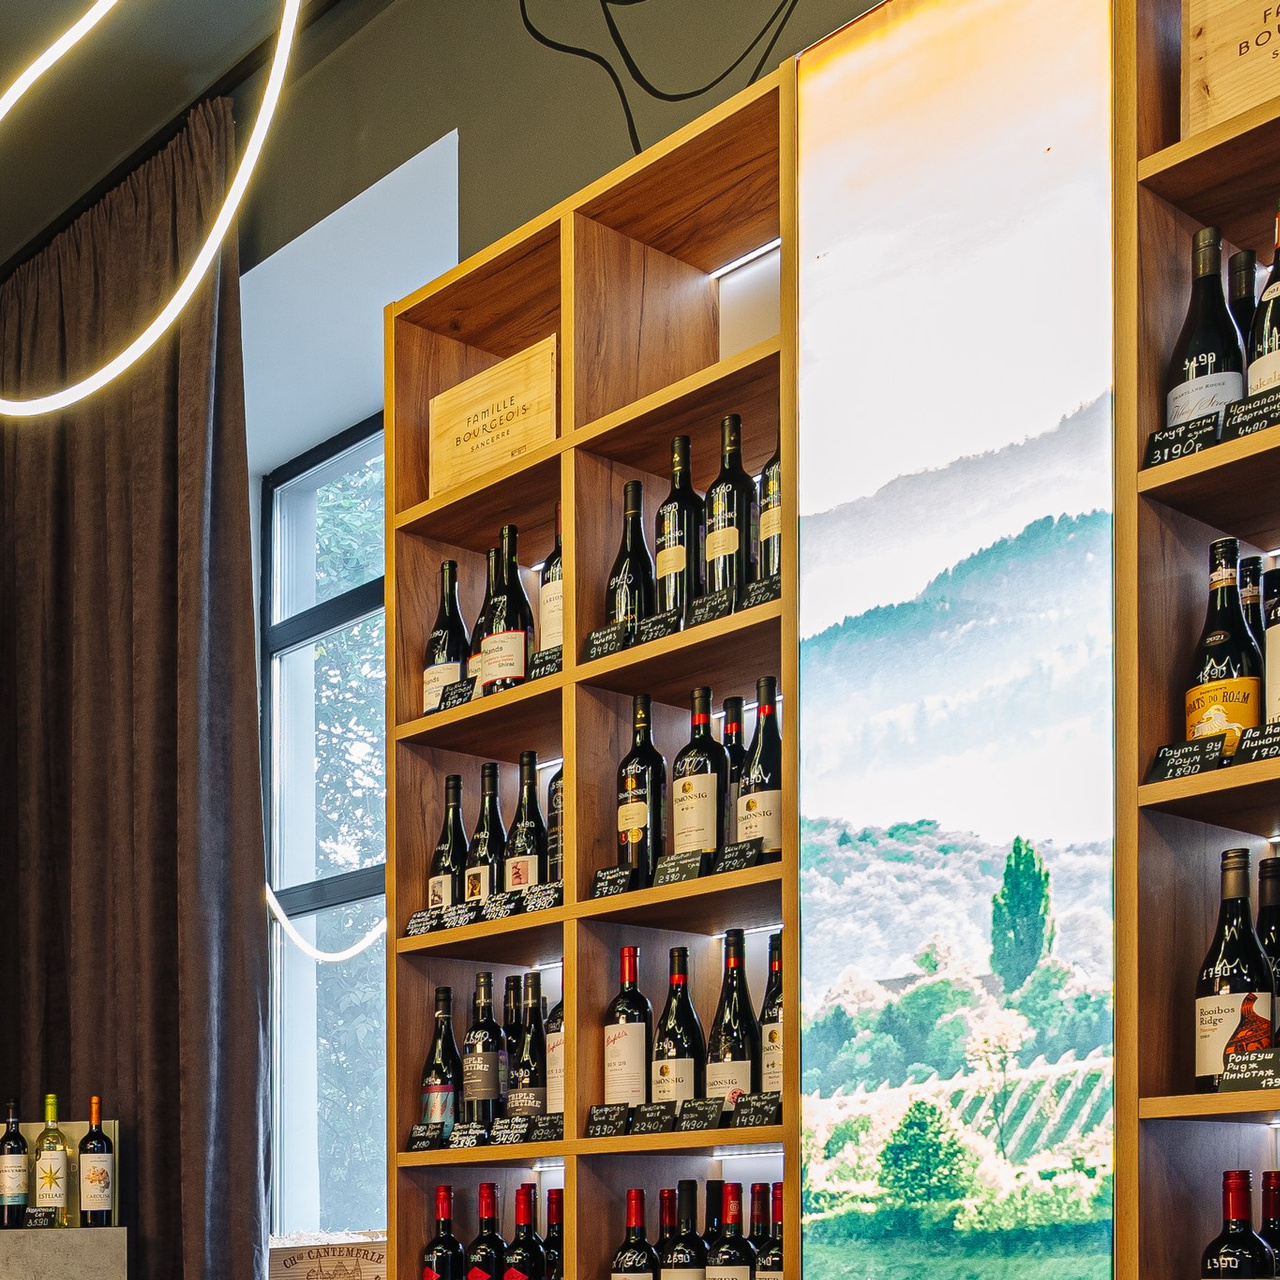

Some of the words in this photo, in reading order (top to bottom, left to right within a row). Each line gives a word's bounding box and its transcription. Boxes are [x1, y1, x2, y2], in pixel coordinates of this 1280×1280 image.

[467, 396, 515, 428] FAMILLE
[455, 404, 528, 447] BOURGEOIS
[470, 429, 511, 452] SANCERRE
[1208, 695, 1218, 703] DO
[1222, 691, 1250, 704] ROAM
[674, 792, 707, 805] SIMONSIG
[738, 810, 772, 823] SIMONSIG
[1200, 1006, 1235, 1017] Rooibos
[1200, 1016, 1223, 1026] Ridge
[308, 1247, 385, 1264] CANTEMERLE
